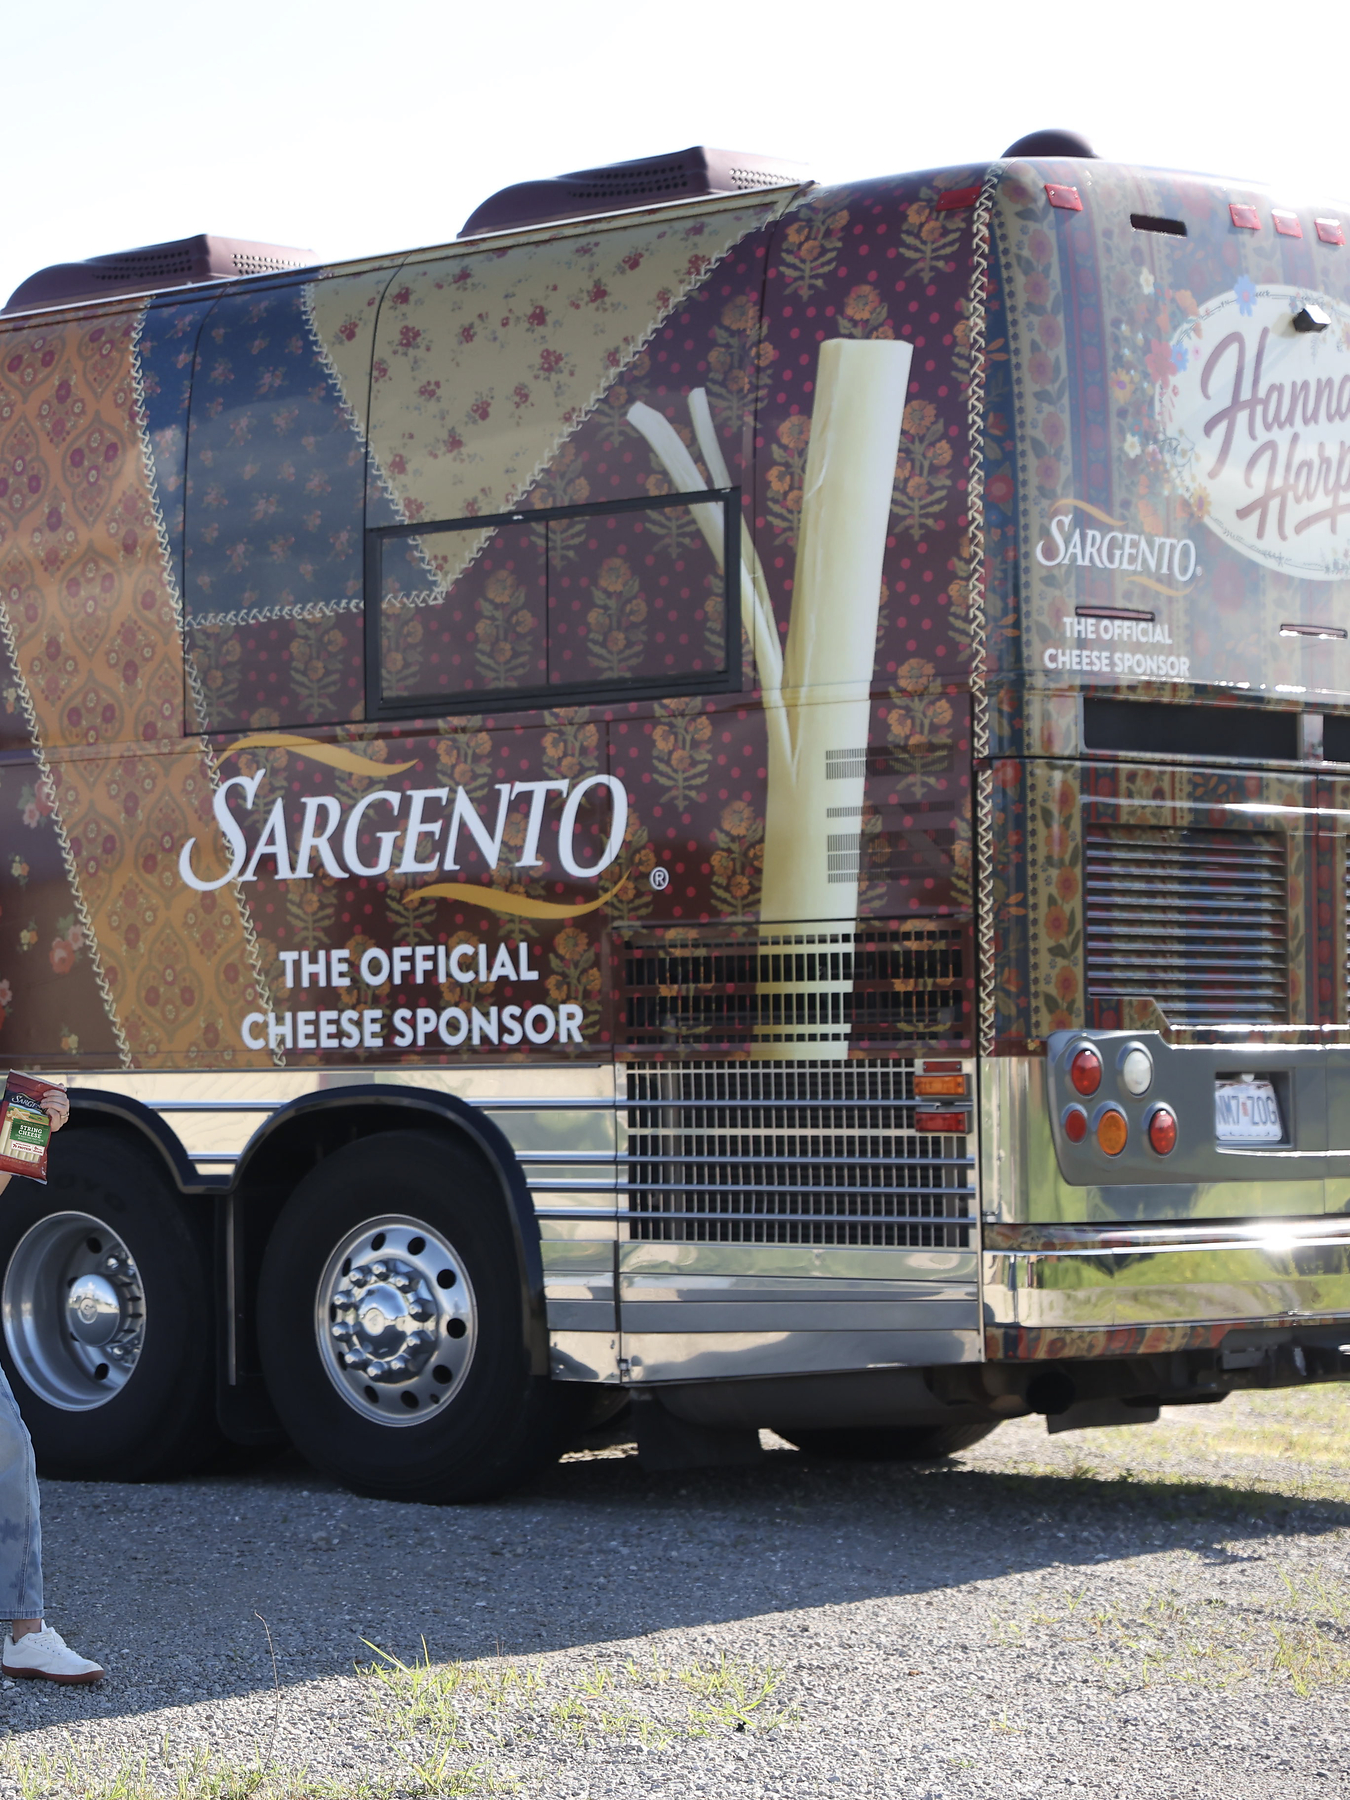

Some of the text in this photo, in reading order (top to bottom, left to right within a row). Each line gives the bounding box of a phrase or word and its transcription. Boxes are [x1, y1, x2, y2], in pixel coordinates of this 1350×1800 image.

[1200, 326, 1350, 480] Hanna
[1236, 432, 1350, 542] Harp
[1035, 514, 1197, 582] SARGENTO
[1063, 617, 1173, 645] THE OFFICIAL
[1043, 648, 1190, 677] CHEESE SPONSOR
[178, 769, 628, 892] SARGENTO
[279, 942, 539, 989] THE OFFICIAL
[241, 1004, 584, 1051] CHEESE SPONSOR
[18, 1129, 42, 1139] CHEESE
[19, 1124, 43, 1134] STRING
